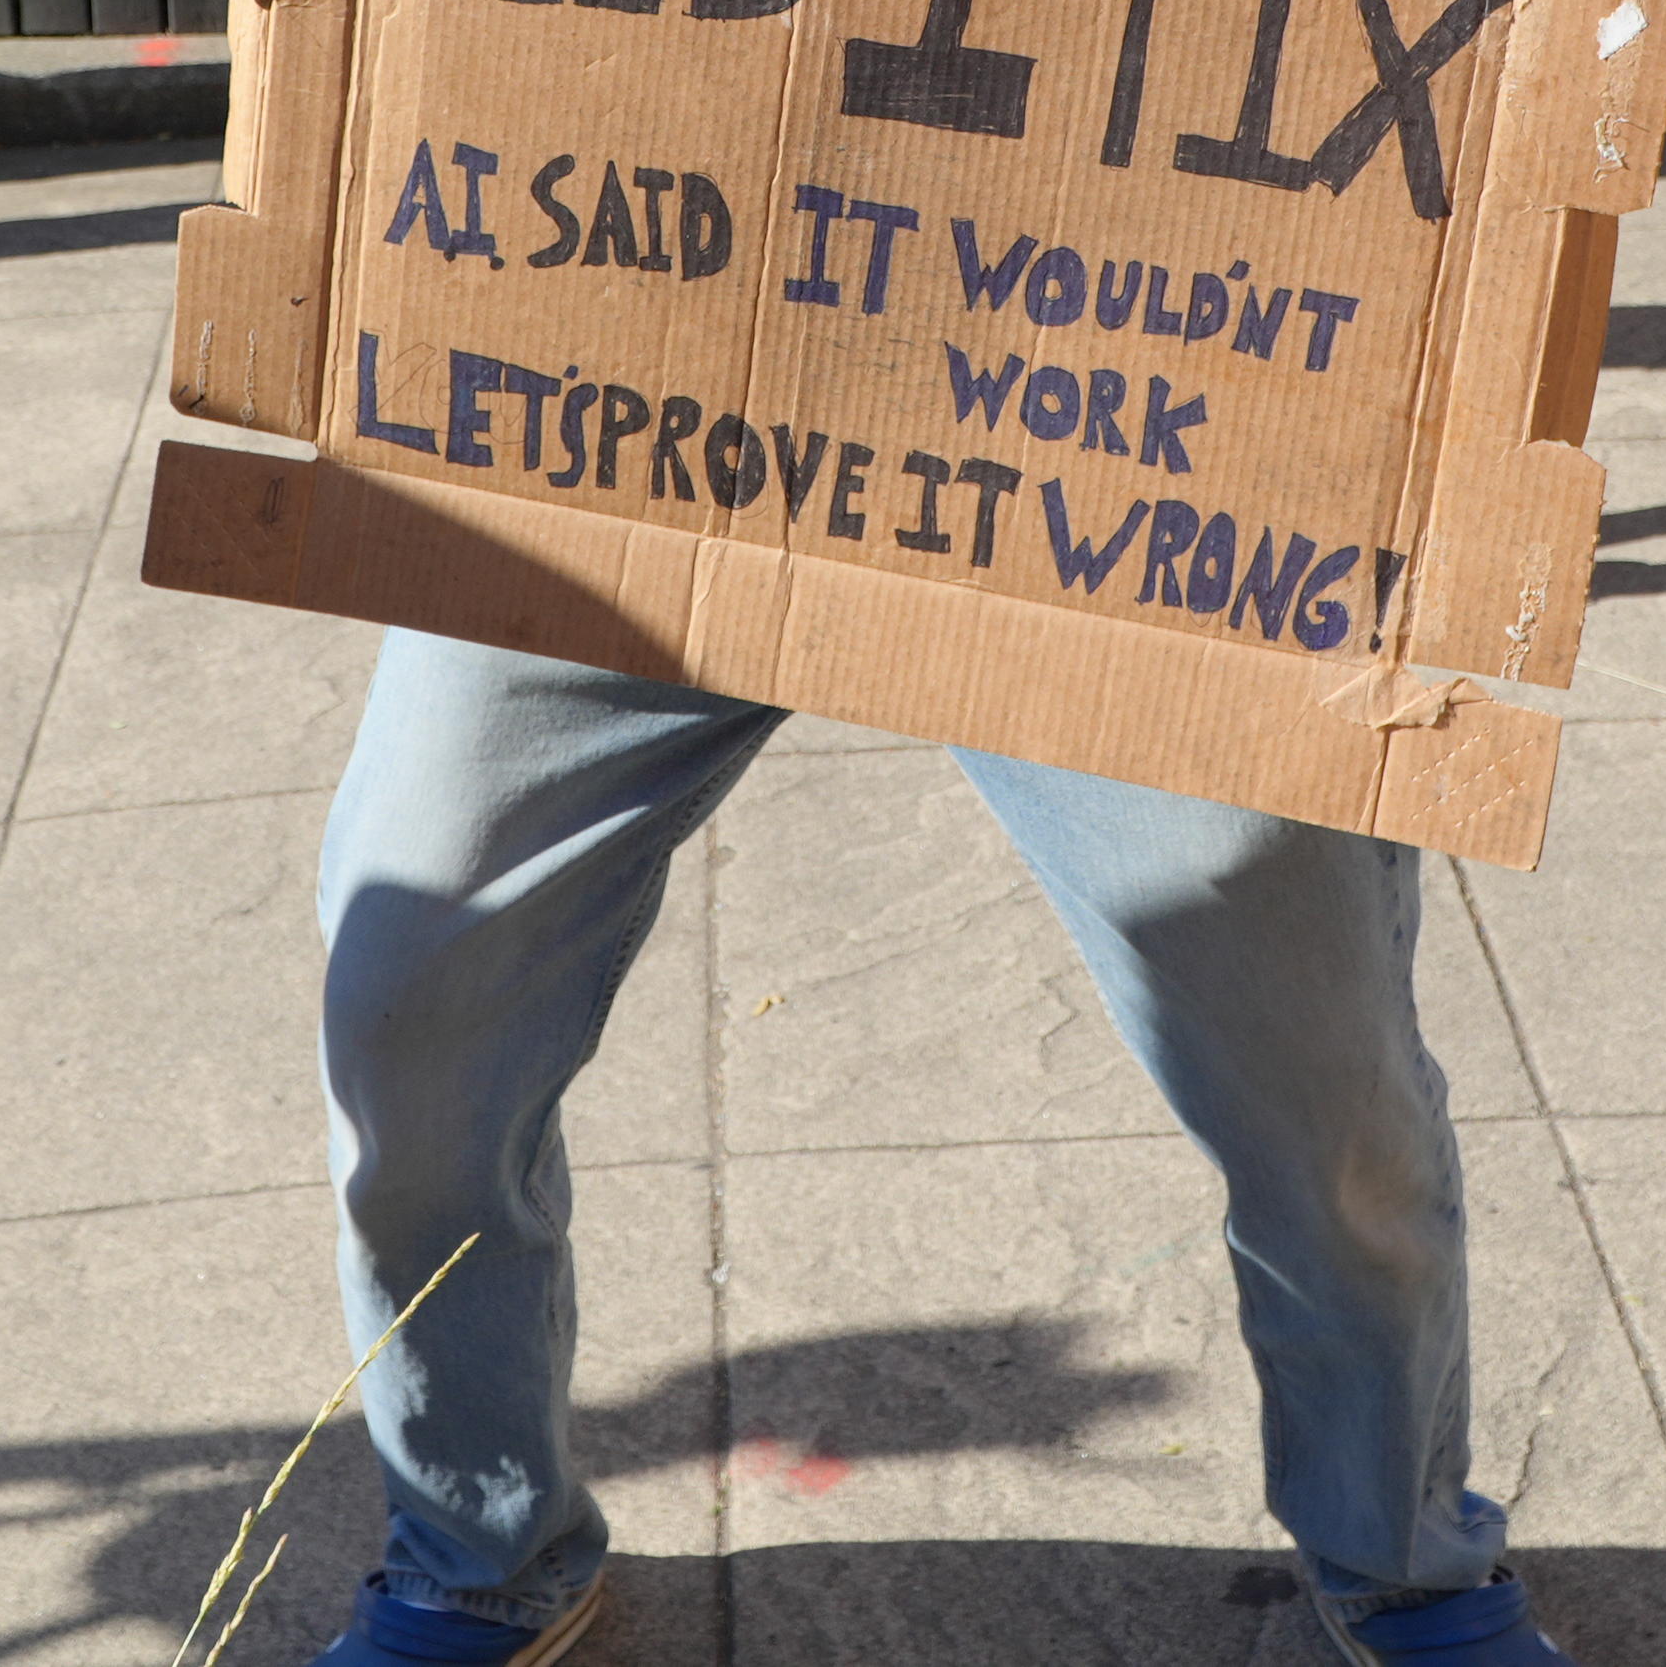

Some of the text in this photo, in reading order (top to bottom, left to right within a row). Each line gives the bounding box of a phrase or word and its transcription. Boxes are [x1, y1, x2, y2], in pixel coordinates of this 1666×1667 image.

[527, 154, 733, 281] SAID
[784, 184, 920, 316] IT
[945, 341, 1206, 474] WORK
[895, 450, 1023, 567] IT
[1038, 477, 1408, 654] WRONG!
